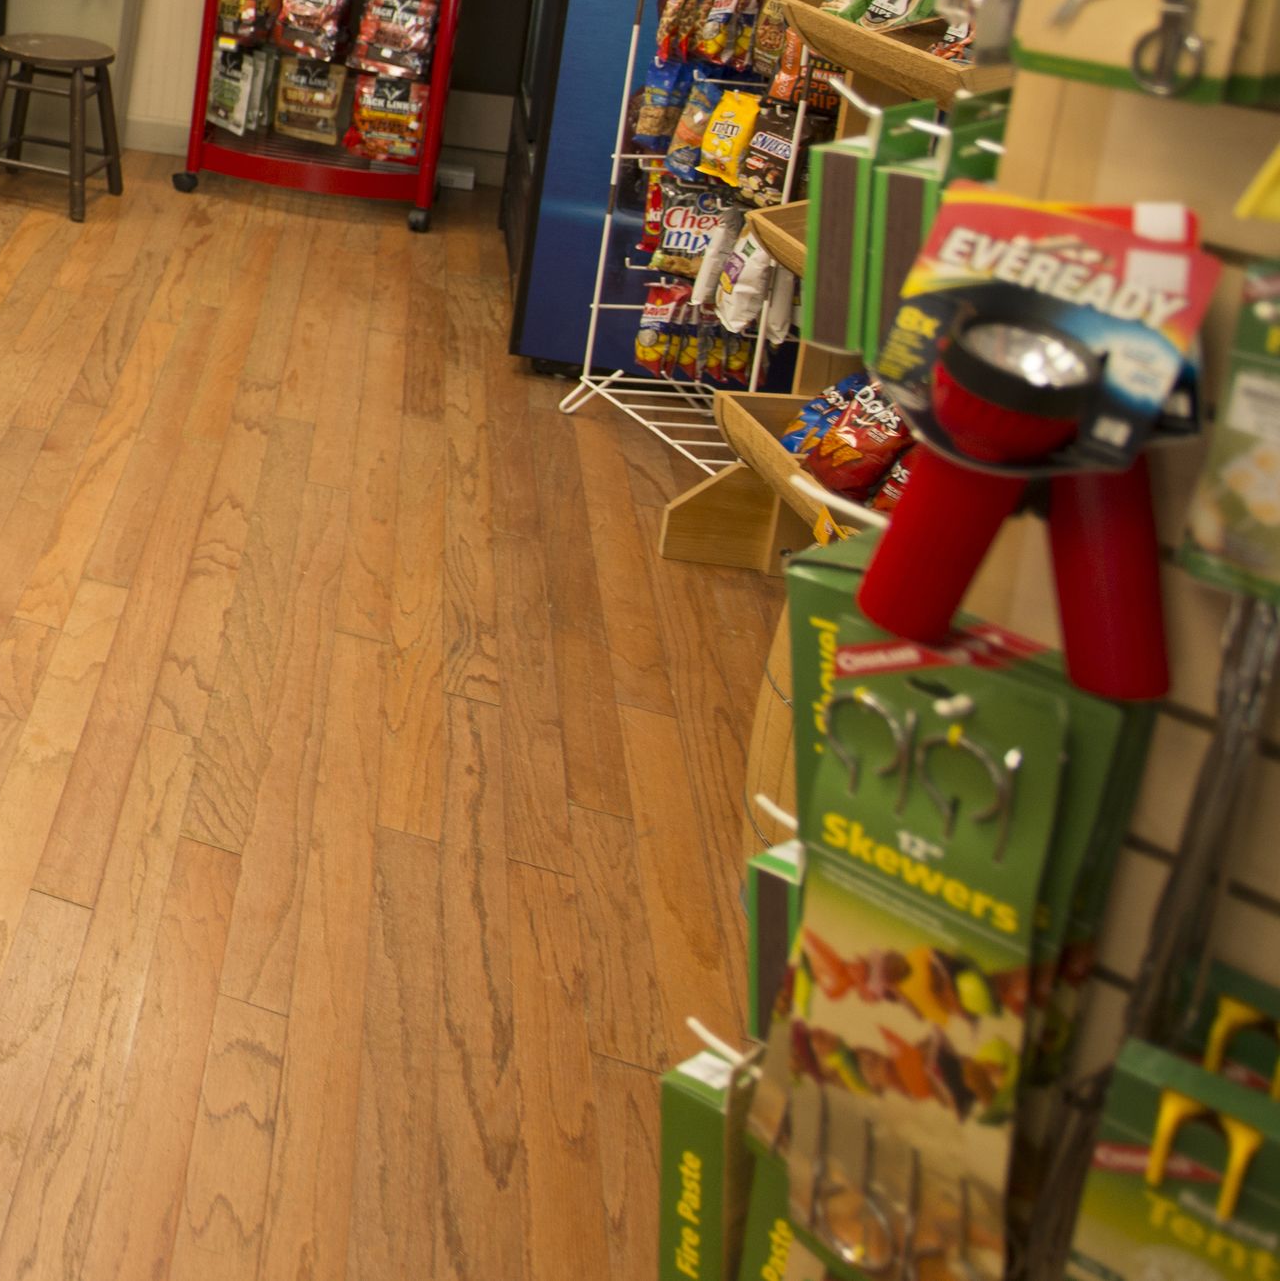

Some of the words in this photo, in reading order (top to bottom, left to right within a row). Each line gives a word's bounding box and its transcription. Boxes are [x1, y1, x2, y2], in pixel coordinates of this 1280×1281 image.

[361, 95, 385, 107] JACK
[752, 131, 793, 161] SNICKERS
[664, 206, 721, 230] Chex
[665, 230, 712, 253] mix
[938, 225, 1189, 330] EVEREADY
[822, 812, 1020, 934] Skewers
[676, 1149, 702, 1226] Paste
[674, 1226, 701, 1280] Fire
[760, 1219, 794, 1281] Paste
